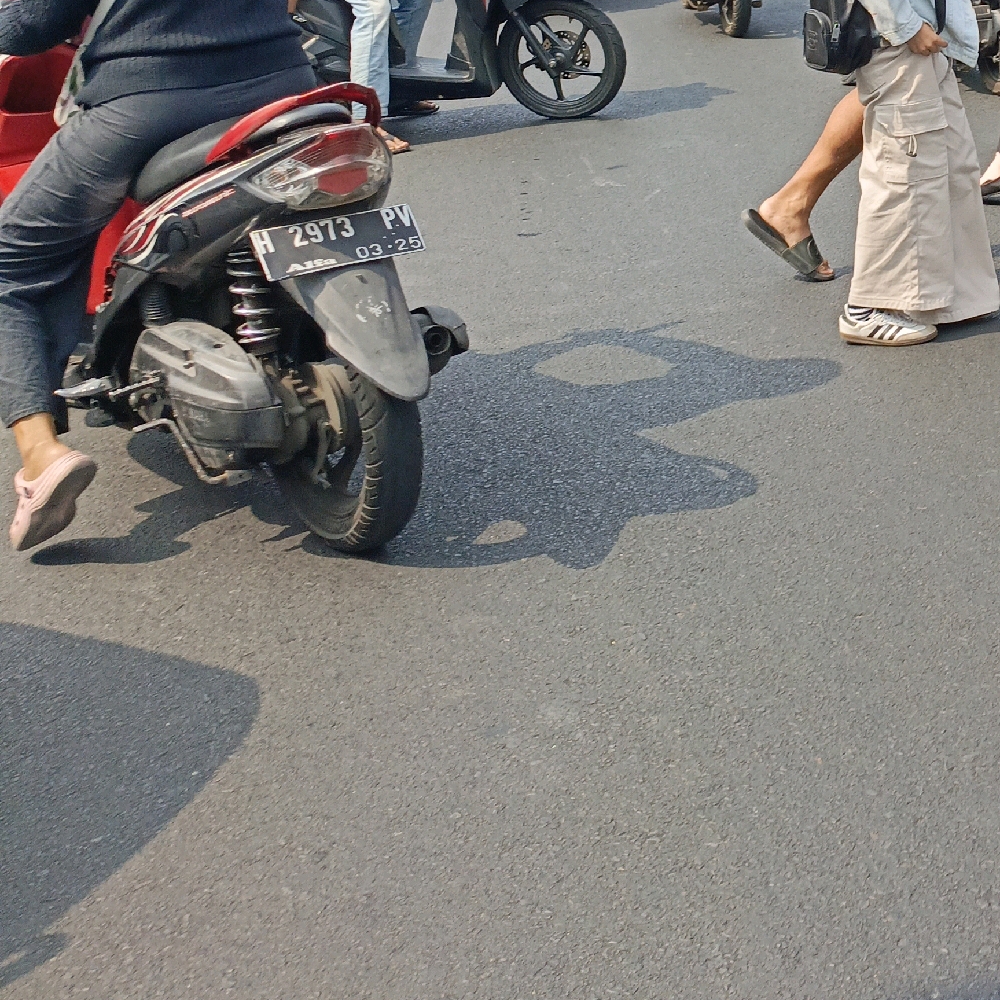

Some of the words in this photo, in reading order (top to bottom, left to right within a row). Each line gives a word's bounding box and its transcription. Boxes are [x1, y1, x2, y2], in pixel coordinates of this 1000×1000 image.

[256, 230, 276, 255] H
[288, 216, 356, 249] 2973
[379, 204, 413, 231] PV
